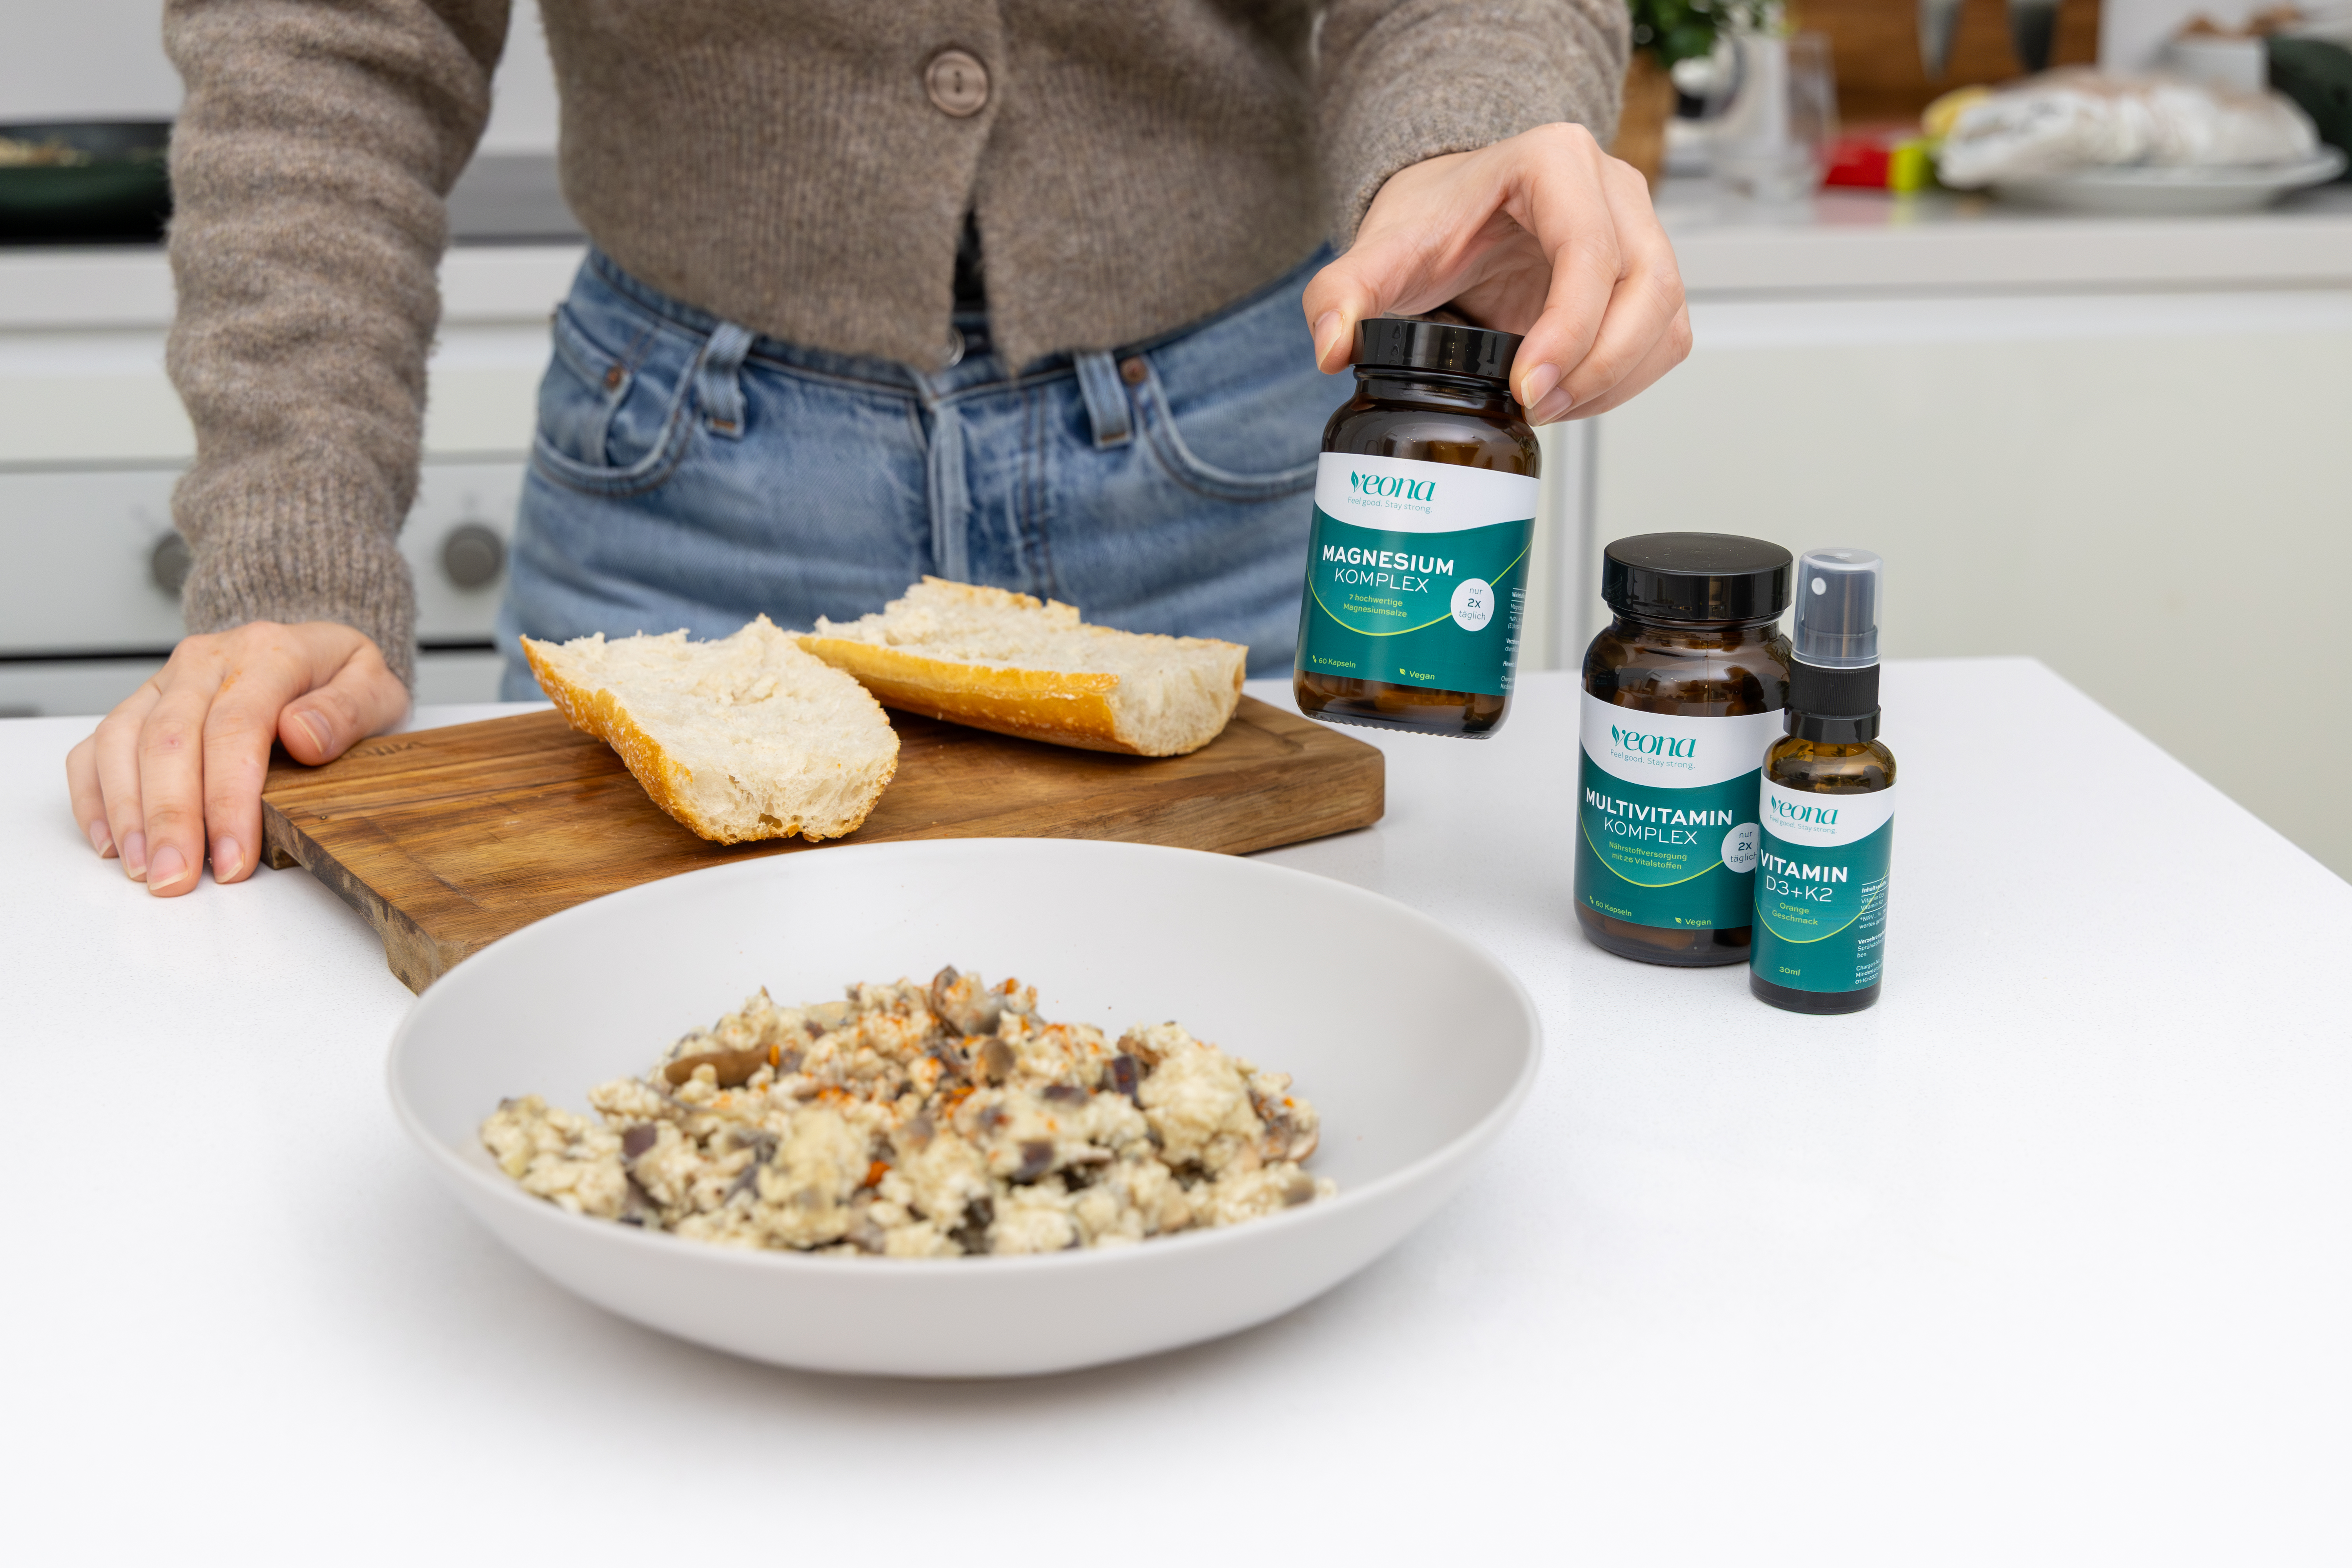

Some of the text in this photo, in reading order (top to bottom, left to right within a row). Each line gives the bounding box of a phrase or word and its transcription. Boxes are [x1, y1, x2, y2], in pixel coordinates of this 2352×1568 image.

[1351, 470, 1436, 501] veona
[1348, 496, 1361, 505] Feel
[1385, 500, 1402, 510] Stay
[1404, 504, 1432, 514] strong.
[1323, 544, 1454, 576] MAGNESIUM
[1335, 568, 1429, 593] KOMPLEX
[1355, 593, 1403, 607] hochwertige
[1467, 598, 1481, 608] 2x
[1343, 603, 1407, 617] Magnesiumsalze
[1459, 610, 1486, 620] täglich
[1328, 659, 1356, 668] Kapseln
[1409, 670, 1435, 681] Vegan
[1612, 724, 1697, 758] veona
[1610, 749, 1695, 770] Feel good. Stay strong.
[1586, 787, 1732, 826] MULTIVITAMIN
[1771, 795, 1838, 825] veona
[1604, 817, 1697, 845] KOMPLEX
[1769, 814, 1837, 835] Feel good. Stay strong.
[1609, 841, 1687, 861] Nährstoffversorgung
[1738, 842, 1752, 851] 2x
[1612, 852, 1623, 860] mit
[1634, 857, 1682, 869] Vitalstoffen
[1760, 849, 1847, 883] VITAMIN
[1766, 875, 1832, 902] D3+K2
[1860, 902, 1878, 910] Vitamin
[1861, 895, 1878, 904] Vitamin
[1605, 903, 1632, 916] Kapseln
[1780, 902, 1809, 915] Orange
[1685, 918, 1711, 927] Vegan
[1772, 910, 1818, 925] Geschmack
[1779, 966, 1800, 976] 30ml
[1856, 966, 1879, 978] Mindestens
